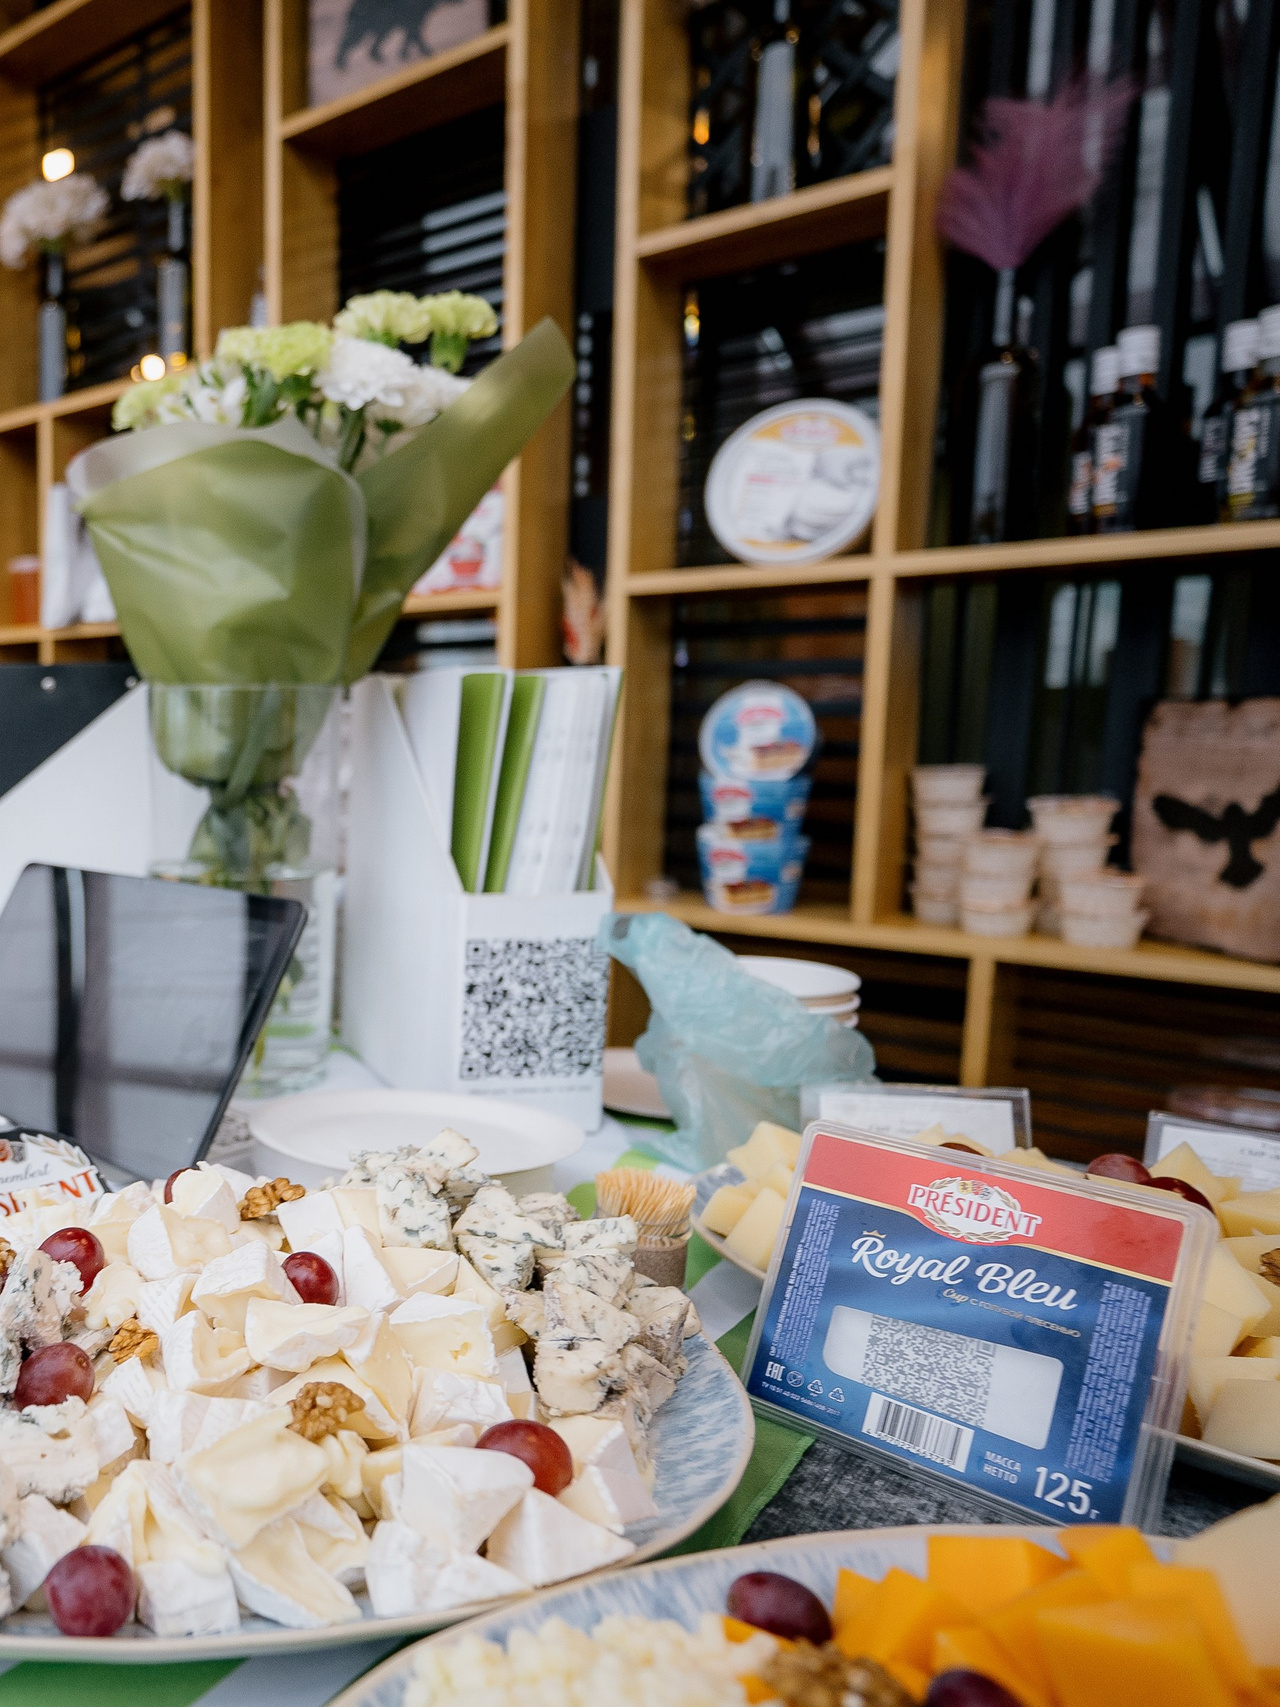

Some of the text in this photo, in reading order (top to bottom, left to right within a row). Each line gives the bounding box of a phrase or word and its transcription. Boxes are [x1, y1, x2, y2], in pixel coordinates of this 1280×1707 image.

[910, 1187, 1040, 1236] PRÉSIDENT
[851, 1236, 1078, 1311] Royal Bleu
